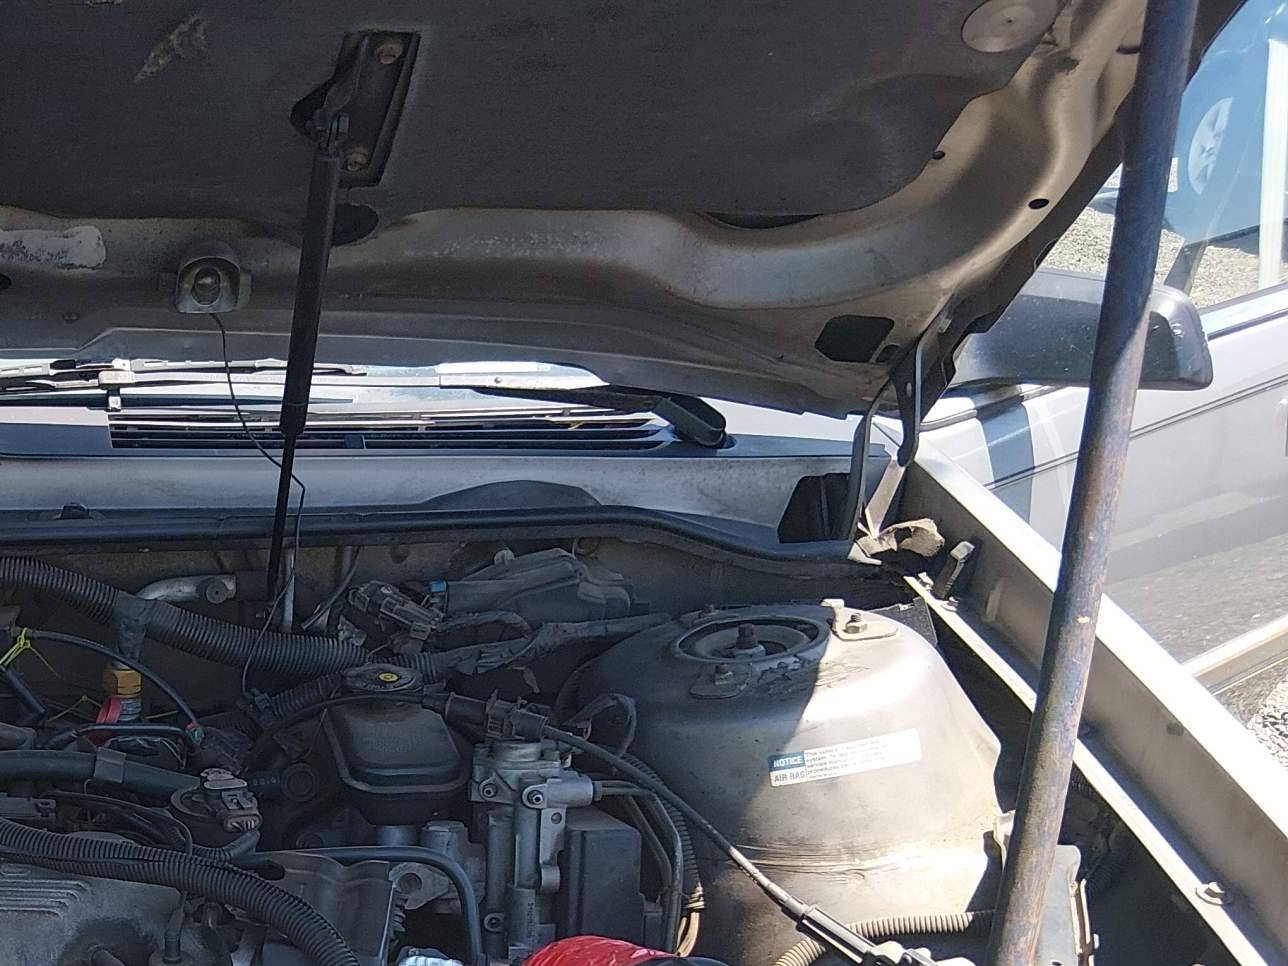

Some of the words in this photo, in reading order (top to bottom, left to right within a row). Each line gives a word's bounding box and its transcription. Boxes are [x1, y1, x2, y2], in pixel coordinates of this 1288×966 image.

[773, 756, 804, 768] NOTICE
[774, 773, 788, 783] AIR
[789, 769, 806, 780] BAG
